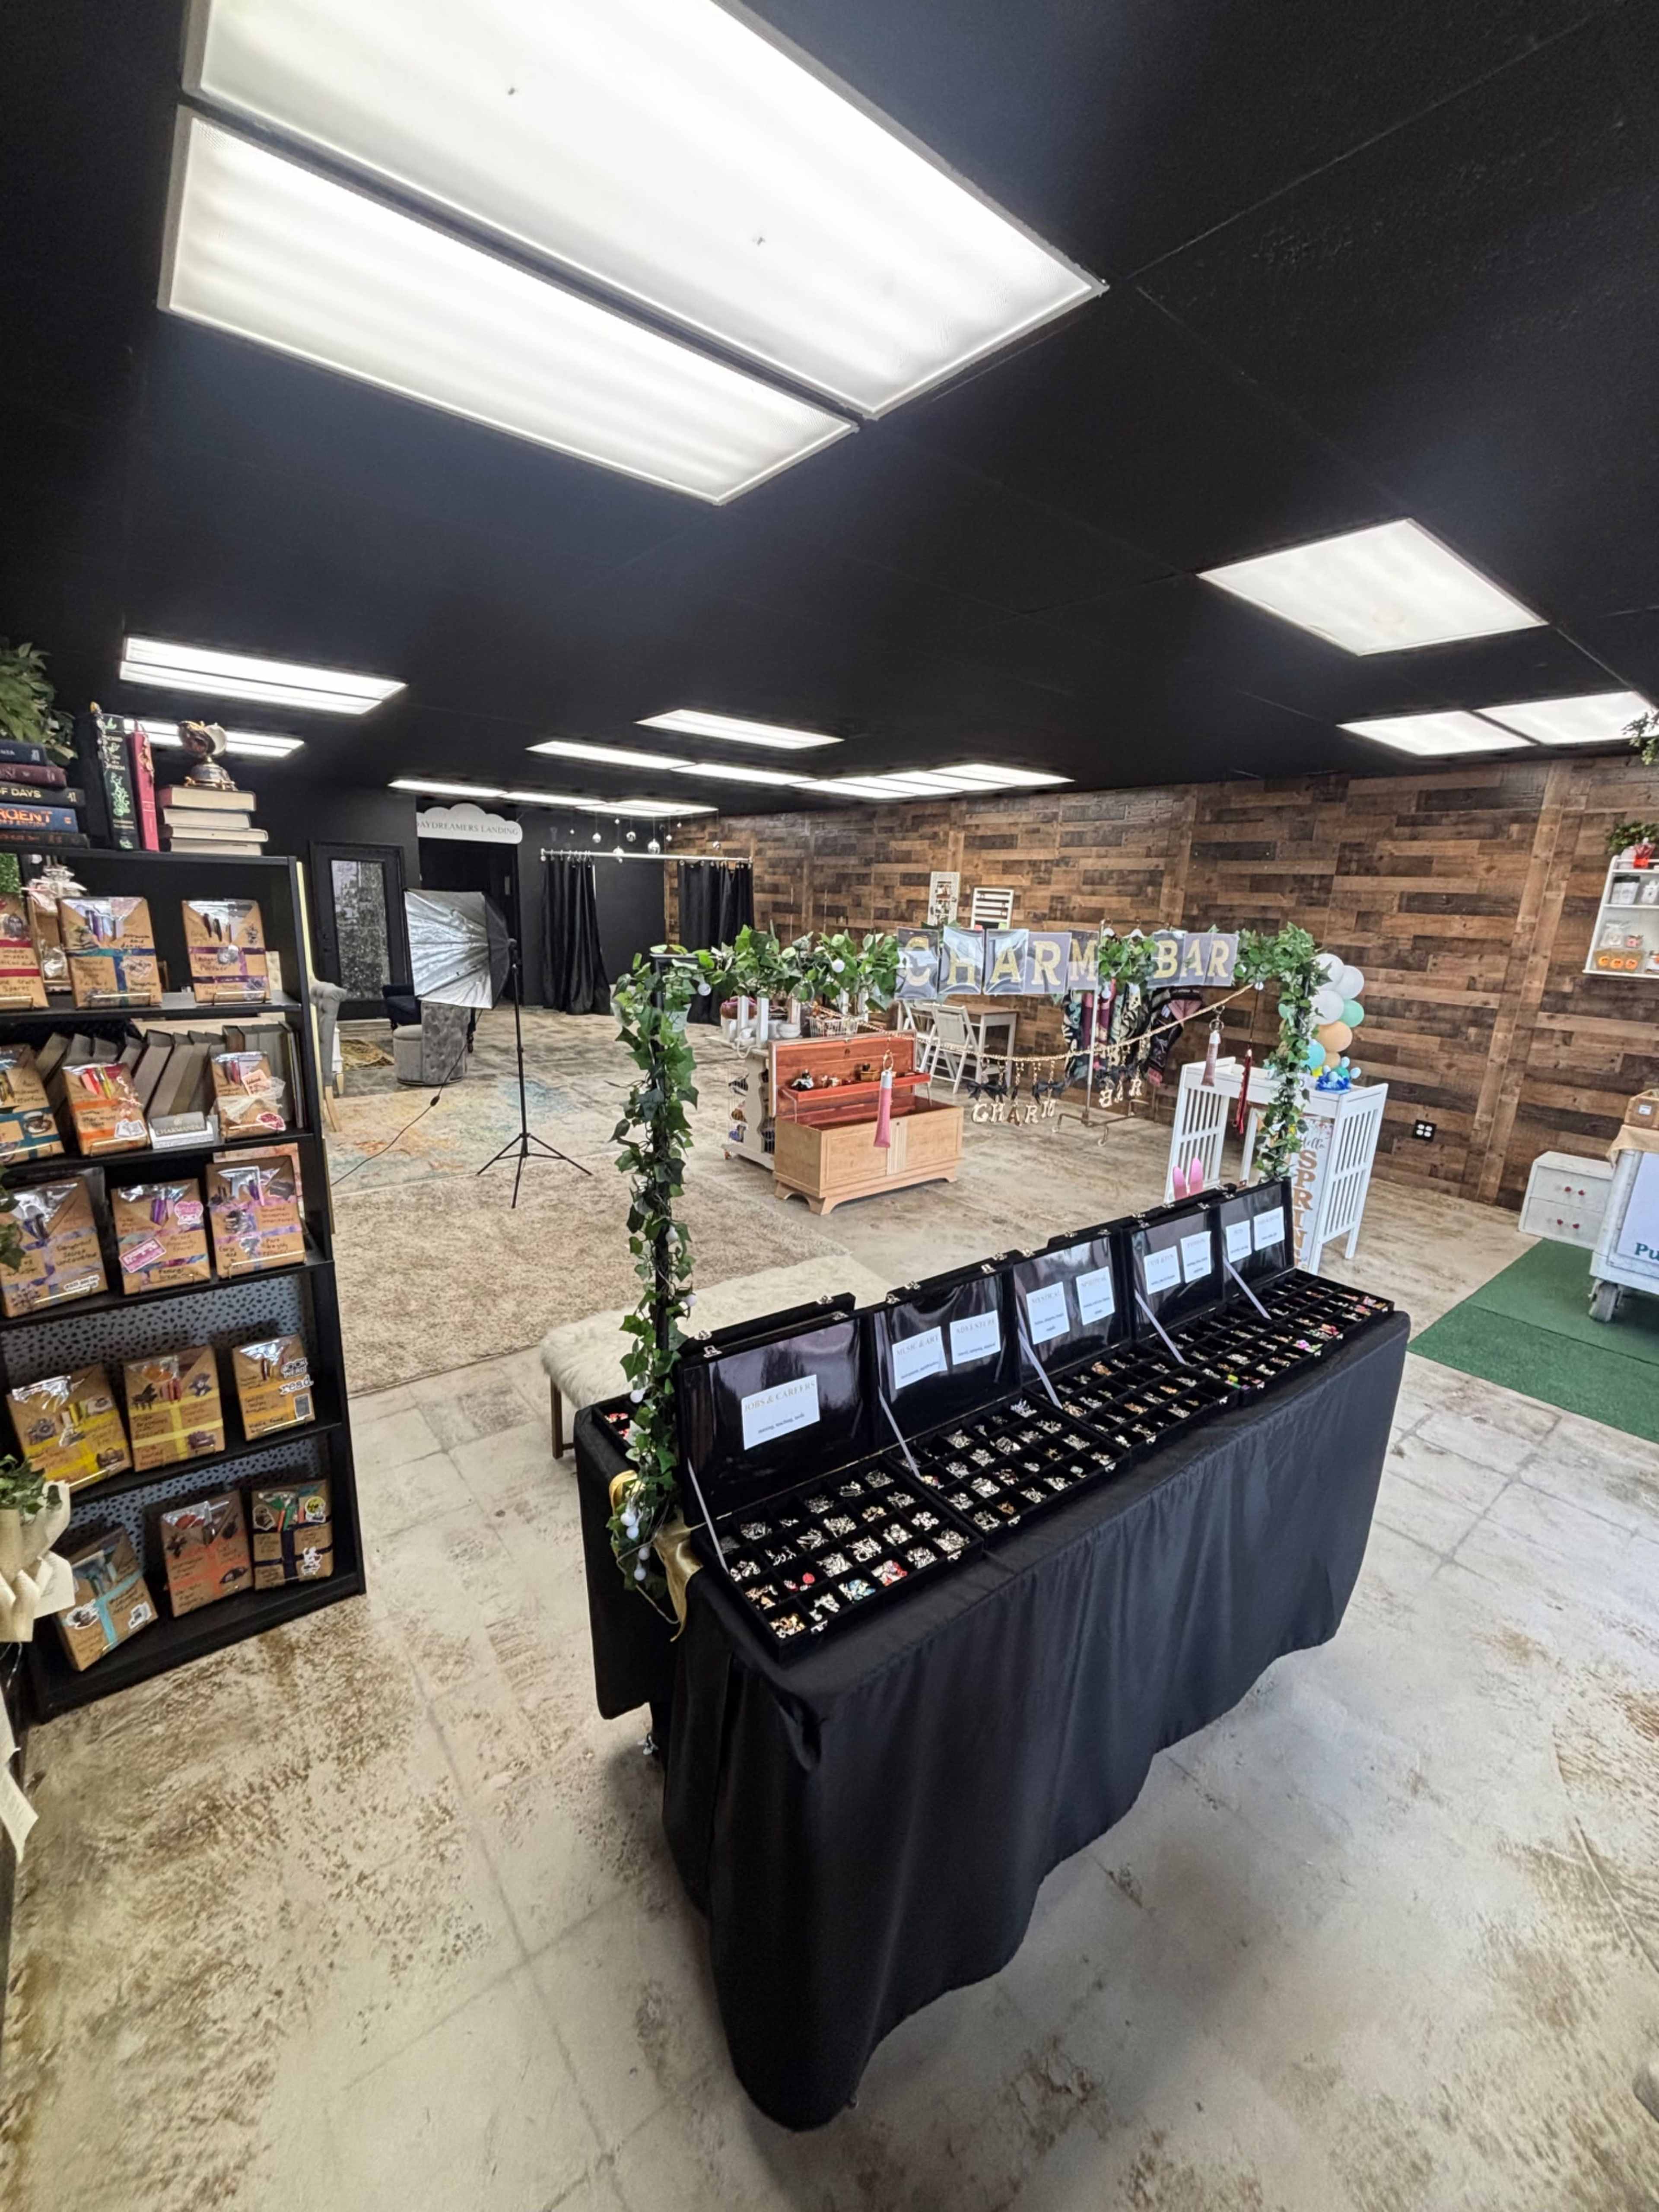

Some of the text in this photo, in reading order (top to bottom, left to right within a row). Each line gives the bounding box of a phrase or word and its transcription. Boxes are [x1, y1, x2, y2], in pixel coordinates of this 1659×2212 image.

[11, 788, 41, 798] DAYS
[481, 826, 518, 836] LANDING
[906, 936, 1230, 986] CHARM BAR
[972, 1100, 1055, 1126] CHARM
[896, 1345, 916, 1356] MUSIC
[926, 1335, 938, 1345] ART
[744, 1399, 765, 1413] JOBS
[775, 1380, 816, 1401] CAREERS
